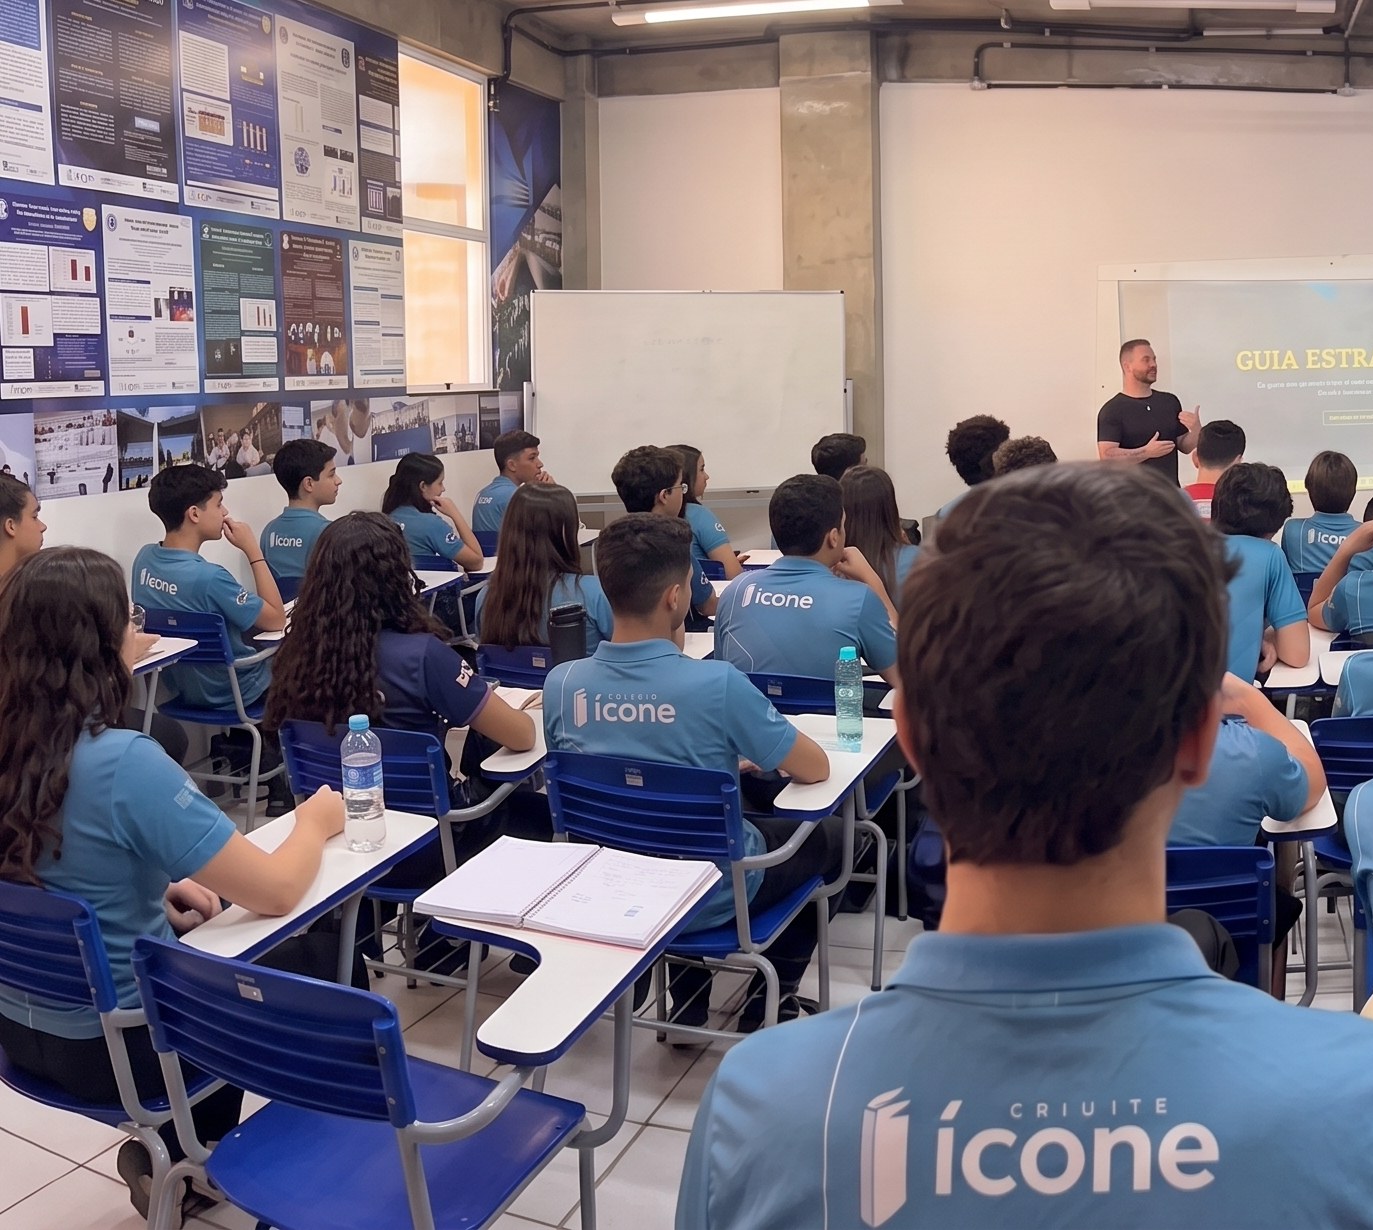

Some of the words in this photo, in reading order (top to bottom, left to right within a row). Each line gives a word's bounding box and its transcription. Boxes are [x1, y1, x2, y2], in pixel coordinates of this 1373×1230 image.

[1235, 349, 1299, 371] GUIA
[608, 693, 657, 701] COLEGIO
[594, 693, 677, 724] ícone
[1009, 1097, 1168, 1119] CRIUITE
[935, 1099, 1220, 1196] ícone
